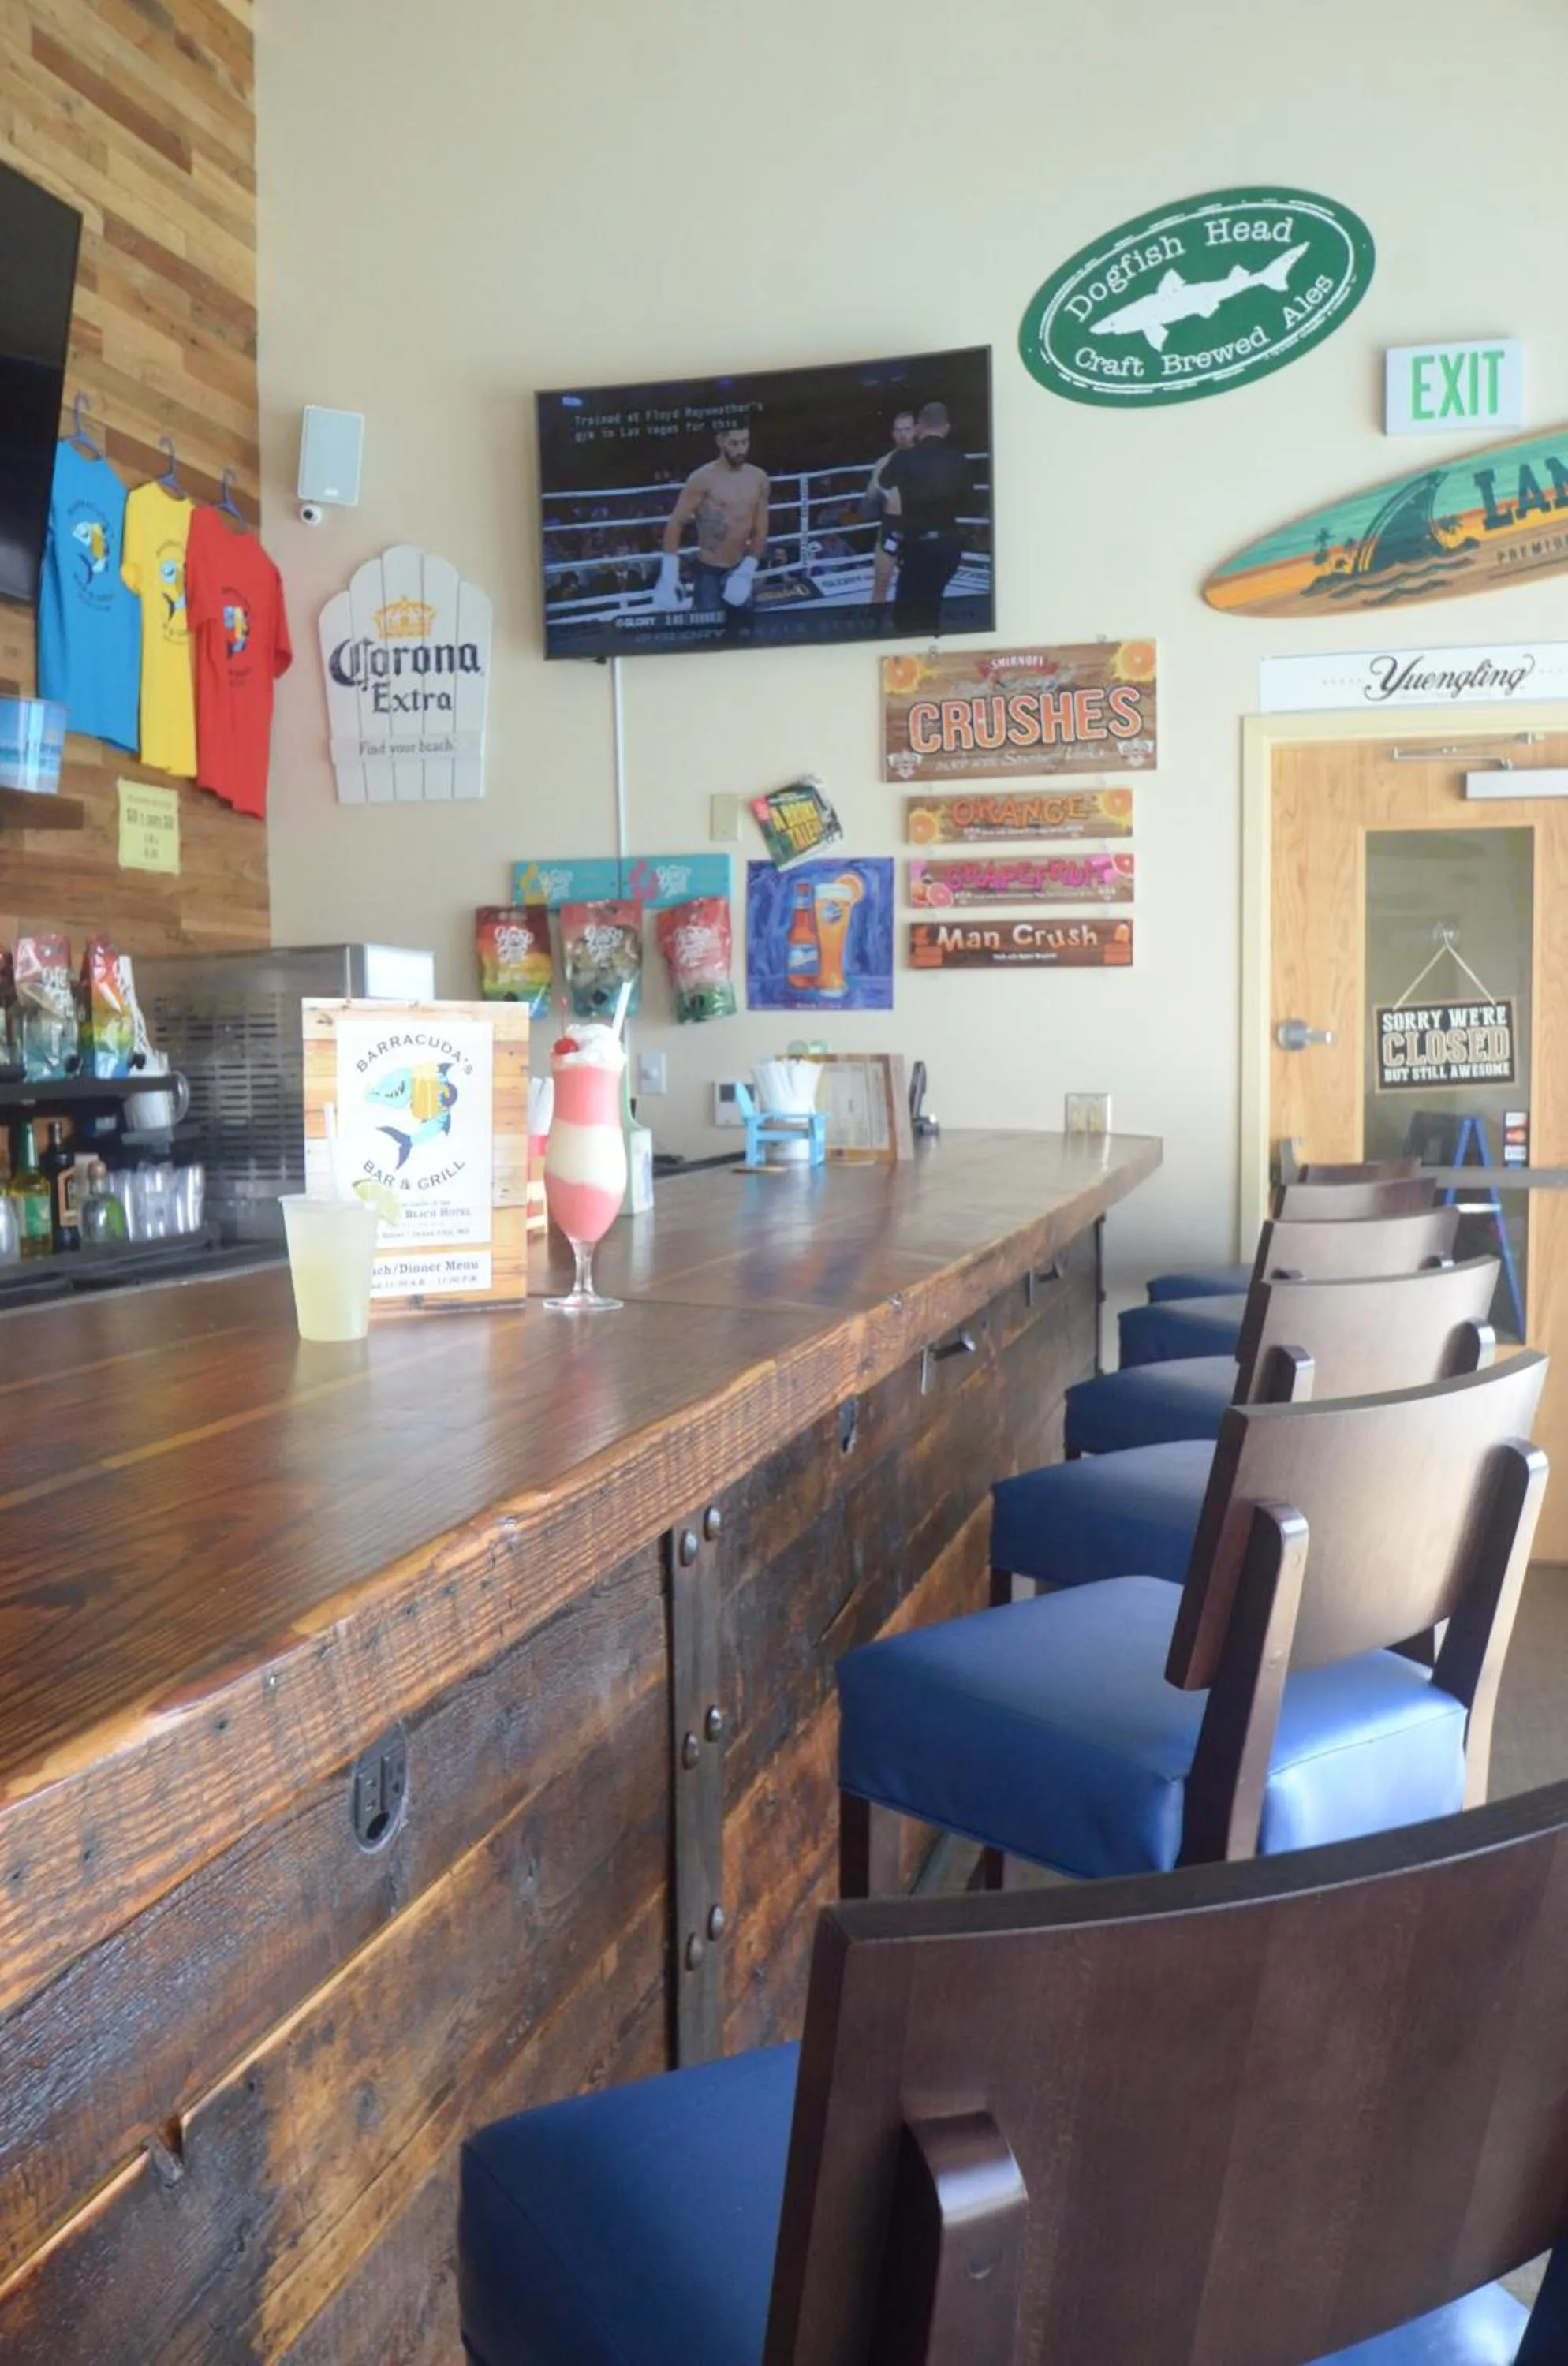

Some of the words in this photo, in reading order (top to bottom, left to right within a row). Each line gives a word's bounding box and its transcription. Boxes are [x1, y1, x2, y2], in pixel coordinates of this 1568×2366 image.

[1064, 235, 1185, 322] Dogfish
[1204, 217, 1294, 246] Head
[1074, 346, 1145, 377] Craft
[1161, 326, 1271, 375] Brewed
[1281, 273, 1334, 330] Ales
[1411, 350, 1506, 420] EXIT
[1498, 532, 1568, 564] PREMIU
[328, 637, 480, 692] Corona
[1364, 653, 1535, 702] Yuengling
[372, 681, 453, 712] Extra
[909, 685, 1142, 755] CRUSHES
[359, 740, 385, 756] Find
[389, 742, 416, 757] your
[951, 793, 1088, 827] ORANGE
[937, 925, 1001, 953] Man
[1012, 924, 1099, 950] Crush
[1383, 1009, 1443, 1032] SORRY
[1448, 1006, 1507, 1028] WE'RE
[356, 1034, 473, 1076] BARRACUDA'S
[1383, 1027, 1510, 1067] CLOSED
[1384, 1068, 1409, 1083] BUT
[1412, 1065, 1447, 1081] STILL
[1450, 1062, 1510, 1079] AWESOME
[363, 1159, 395, 1187] BAR
[400, 1178, 411, 1190] &
[417, 1160, 466, 1190] GRILL
[445, 1260, 480, 1271] Menu
